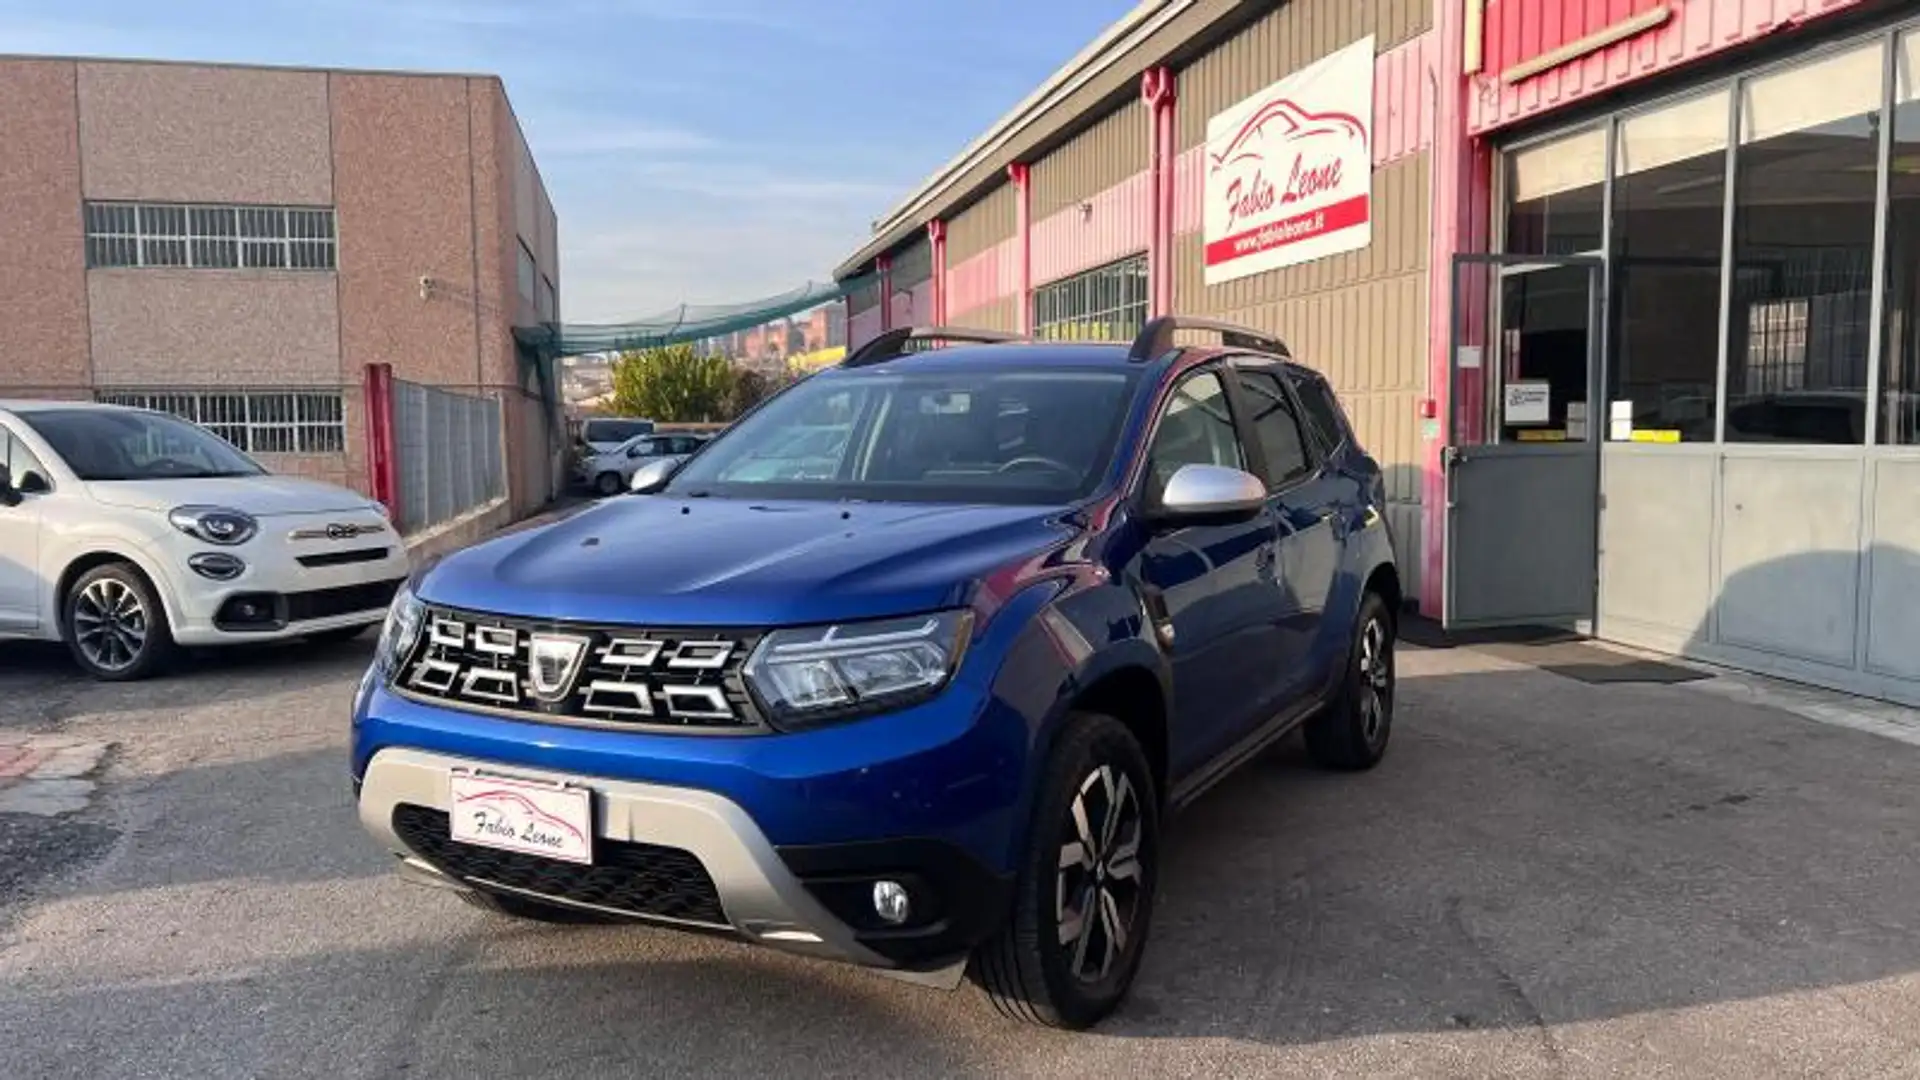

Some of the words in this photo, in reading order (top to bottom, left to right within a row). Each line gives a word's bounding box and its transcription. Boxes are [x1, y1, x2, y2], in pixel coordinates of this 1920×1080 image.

[1226, 169, 1275, 232] Fabio
[1280, 152, 1342, 206] Leone
[473, 811, 516, 839] Fabio
[520, 822, 565, 849] Leone
